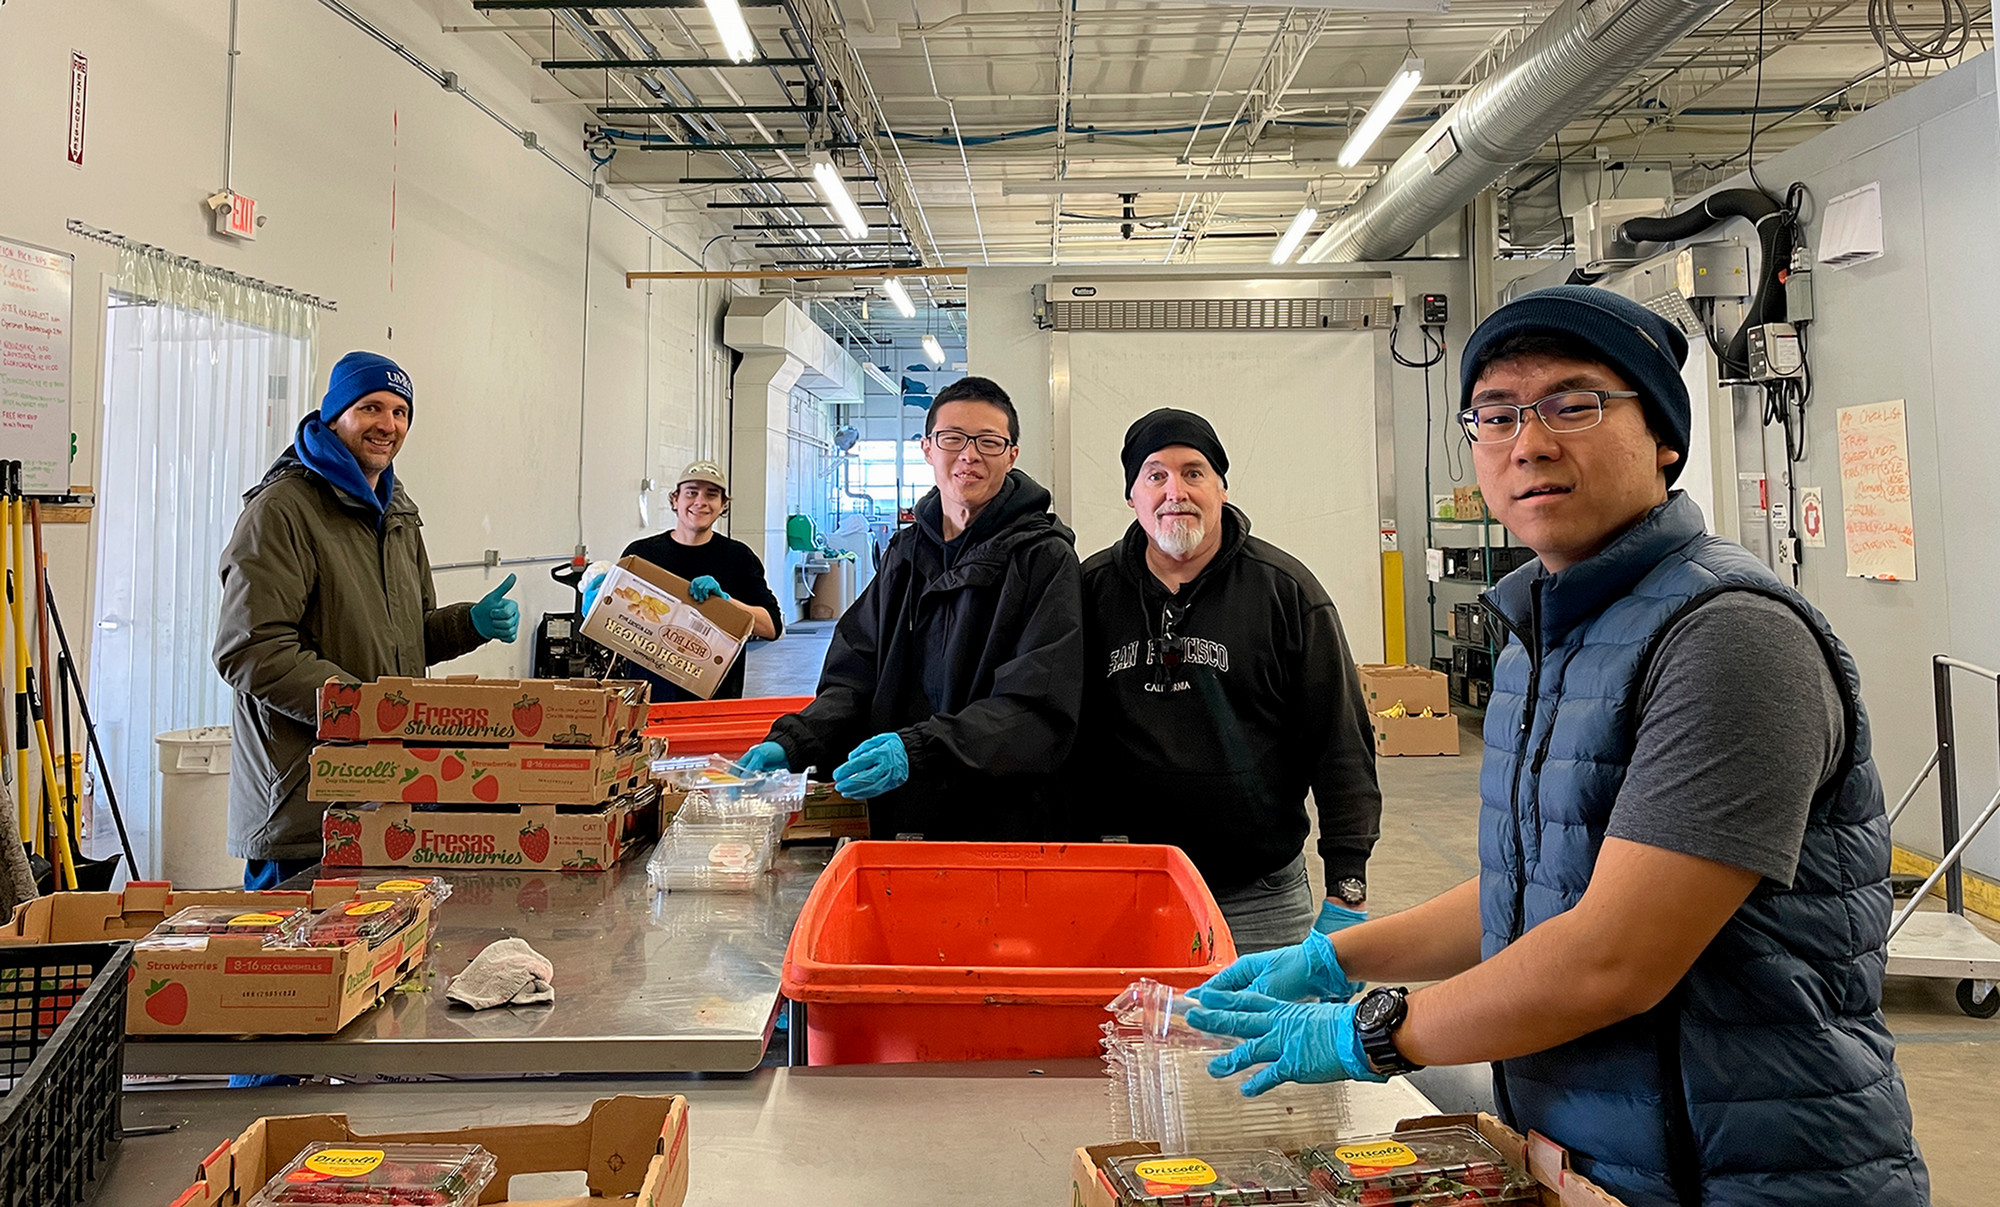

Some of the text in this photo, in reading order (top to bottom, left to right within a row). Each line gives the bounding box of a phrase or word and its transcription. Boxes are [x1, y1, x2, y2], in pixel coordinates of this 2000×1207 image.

[73, 60, 86, 74] FIRE
[73, 73, 82, 156] EXTINGUISHER
[232, 194, 255, 235] EXIT
[605, 618, 658, 655] GINGER
[663, 627, 708, 657] BEST BUY
[657, 647, 704, 679] FRESH
[1107, 640, 1139, 678] SAN
[413, 702, 489, 728] Fresas
[404, 719, 516, 738] Strawberries
[317, 760, 397, 778] Driscoll's
[471, 760, 517, 768] Strawberries
[583, 823, 596, 831] CAT
[421, 829, 496, 853] Fresas
[412, 847, 523, 865] Strawberries
[146, 961, 218, 971] Strawberries
[234, 960, 322, 971] 8-16 OZ CLAMSHELLS
[313, 1154, 379, 1164] Driscoll's
[1342, 1146, 1405, 1159] Driscoll's
[1141, 1164, 1208, 1175] Driscoll's
